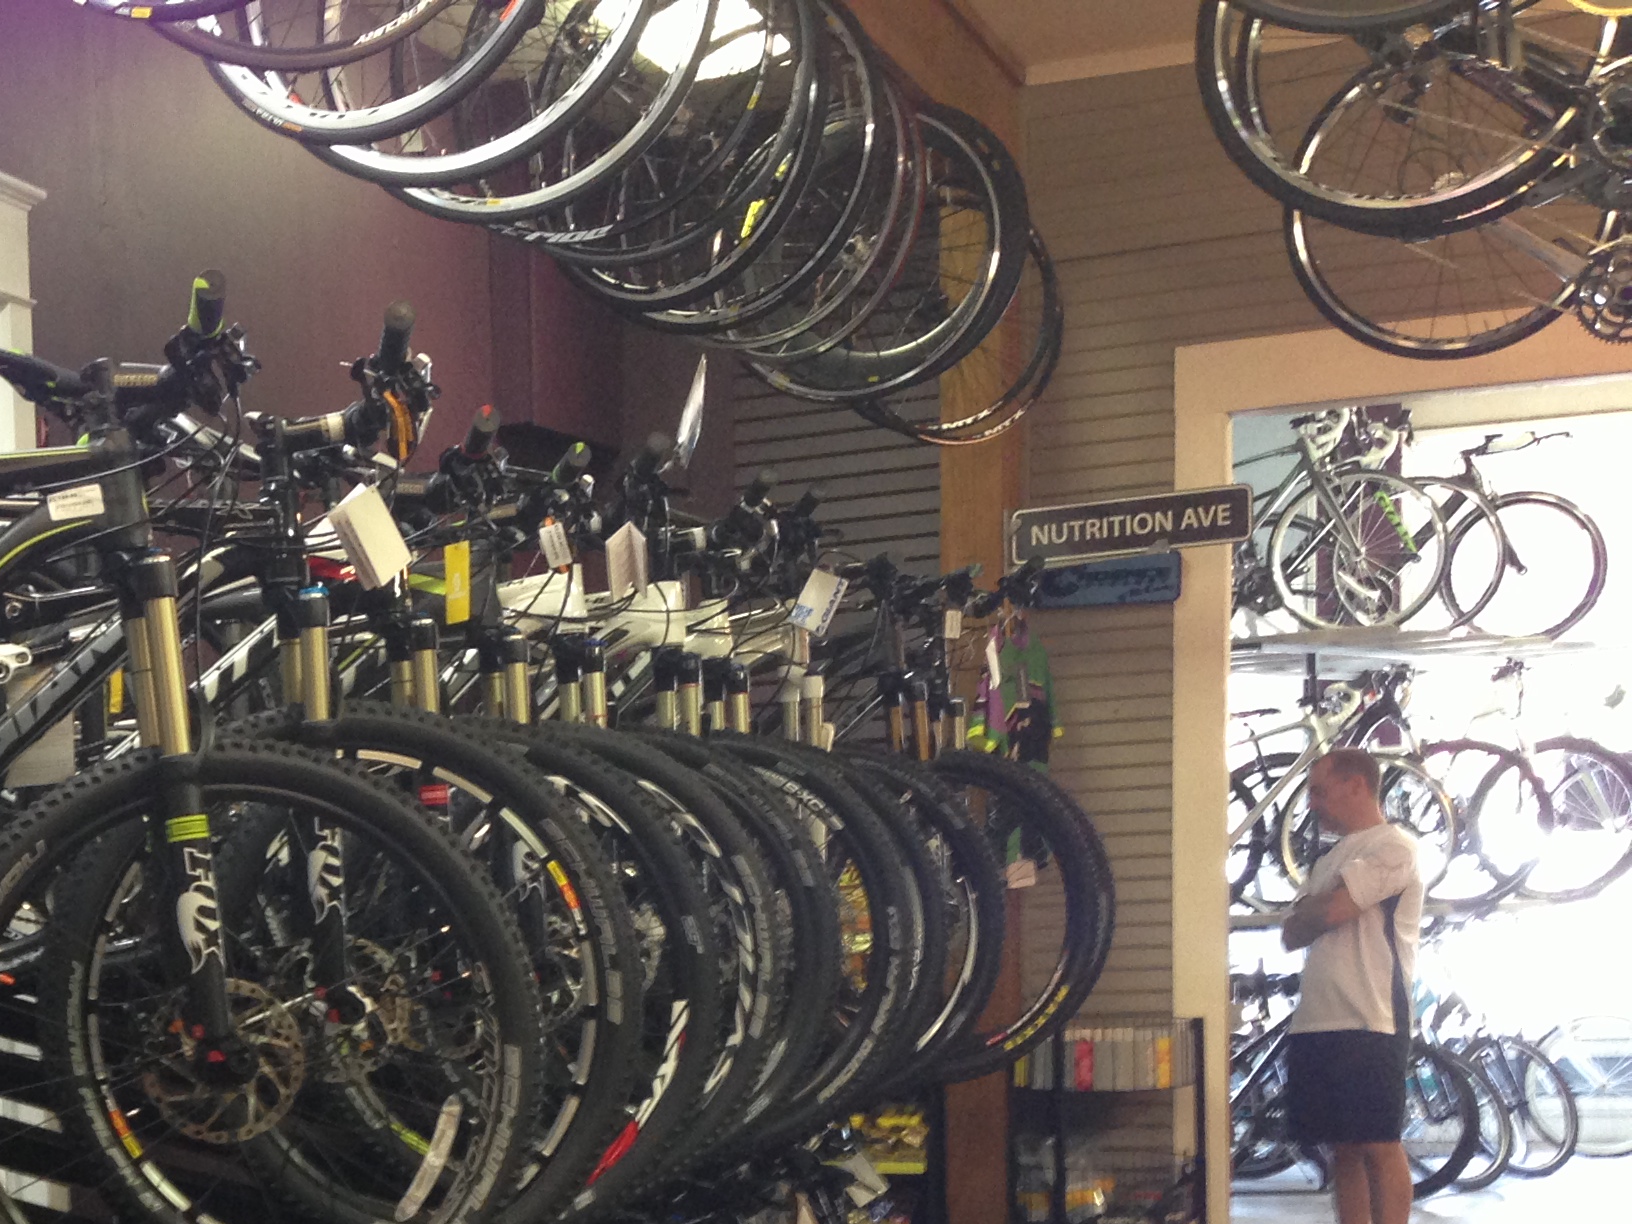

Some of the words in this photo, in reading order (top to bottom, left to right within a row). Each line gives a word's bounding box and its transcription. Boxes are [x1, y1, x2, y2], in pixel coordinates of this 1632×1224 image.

[1029, 510, 1174, 547] NUTRITION
[1179, 503, 1233, 530] AVE
[175, 846, 227, 975] FOX
